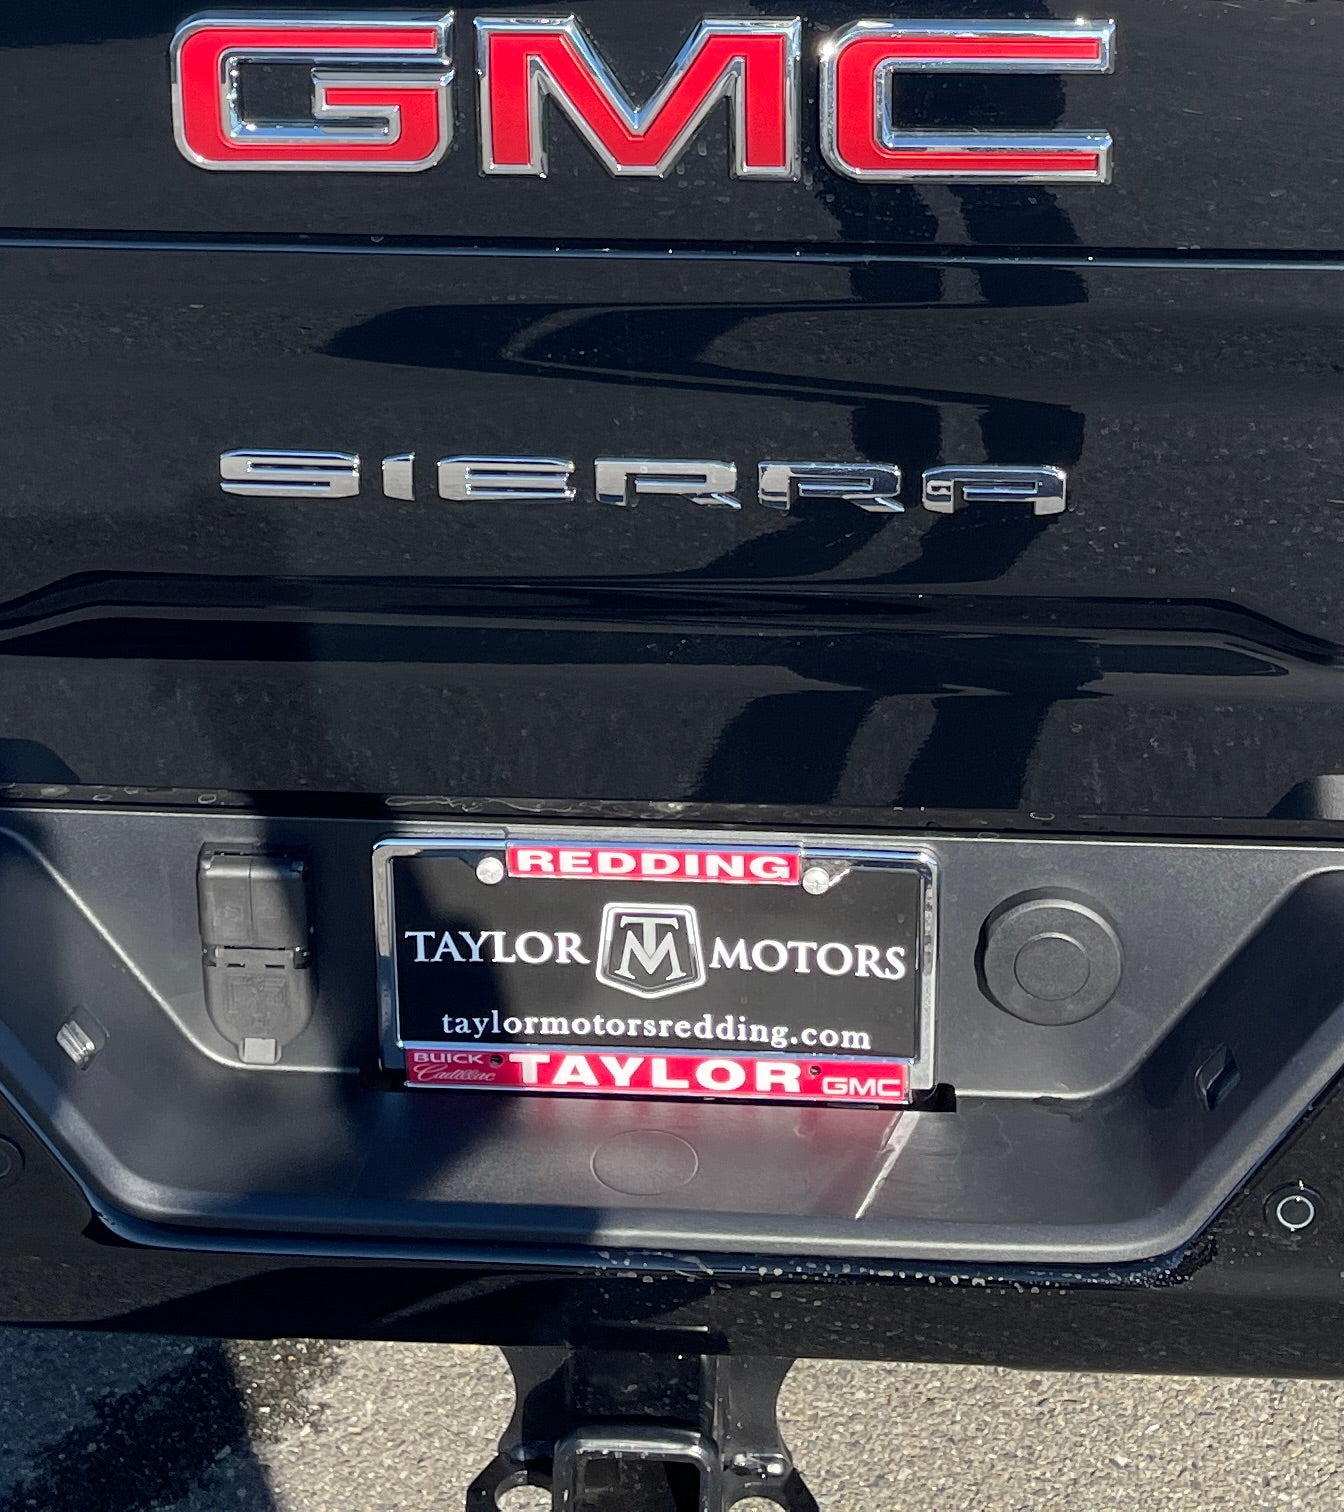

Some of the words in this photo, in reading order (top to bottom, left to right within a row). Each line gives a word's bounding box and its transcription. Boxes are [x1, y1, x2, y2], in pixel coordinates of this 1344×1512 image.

[170, 9, 1117, 184] GMC
[219, 447, 1067, 515] SIERRA
[516, 848, 792, 880] REDDING
[405, 930, 591, 966] TAYLOR
[709, 935, 907, 981] MOTORS
[441, 1009, 872, 1050] taylormotorsredding.com
[413, 1052, 485, 1064] BUICK
[413, 1063, 497, 1082] Cadillac
[508, 1052, 802, 1094] TAYLOR
[821, 1076, 903, 1098] GMC
